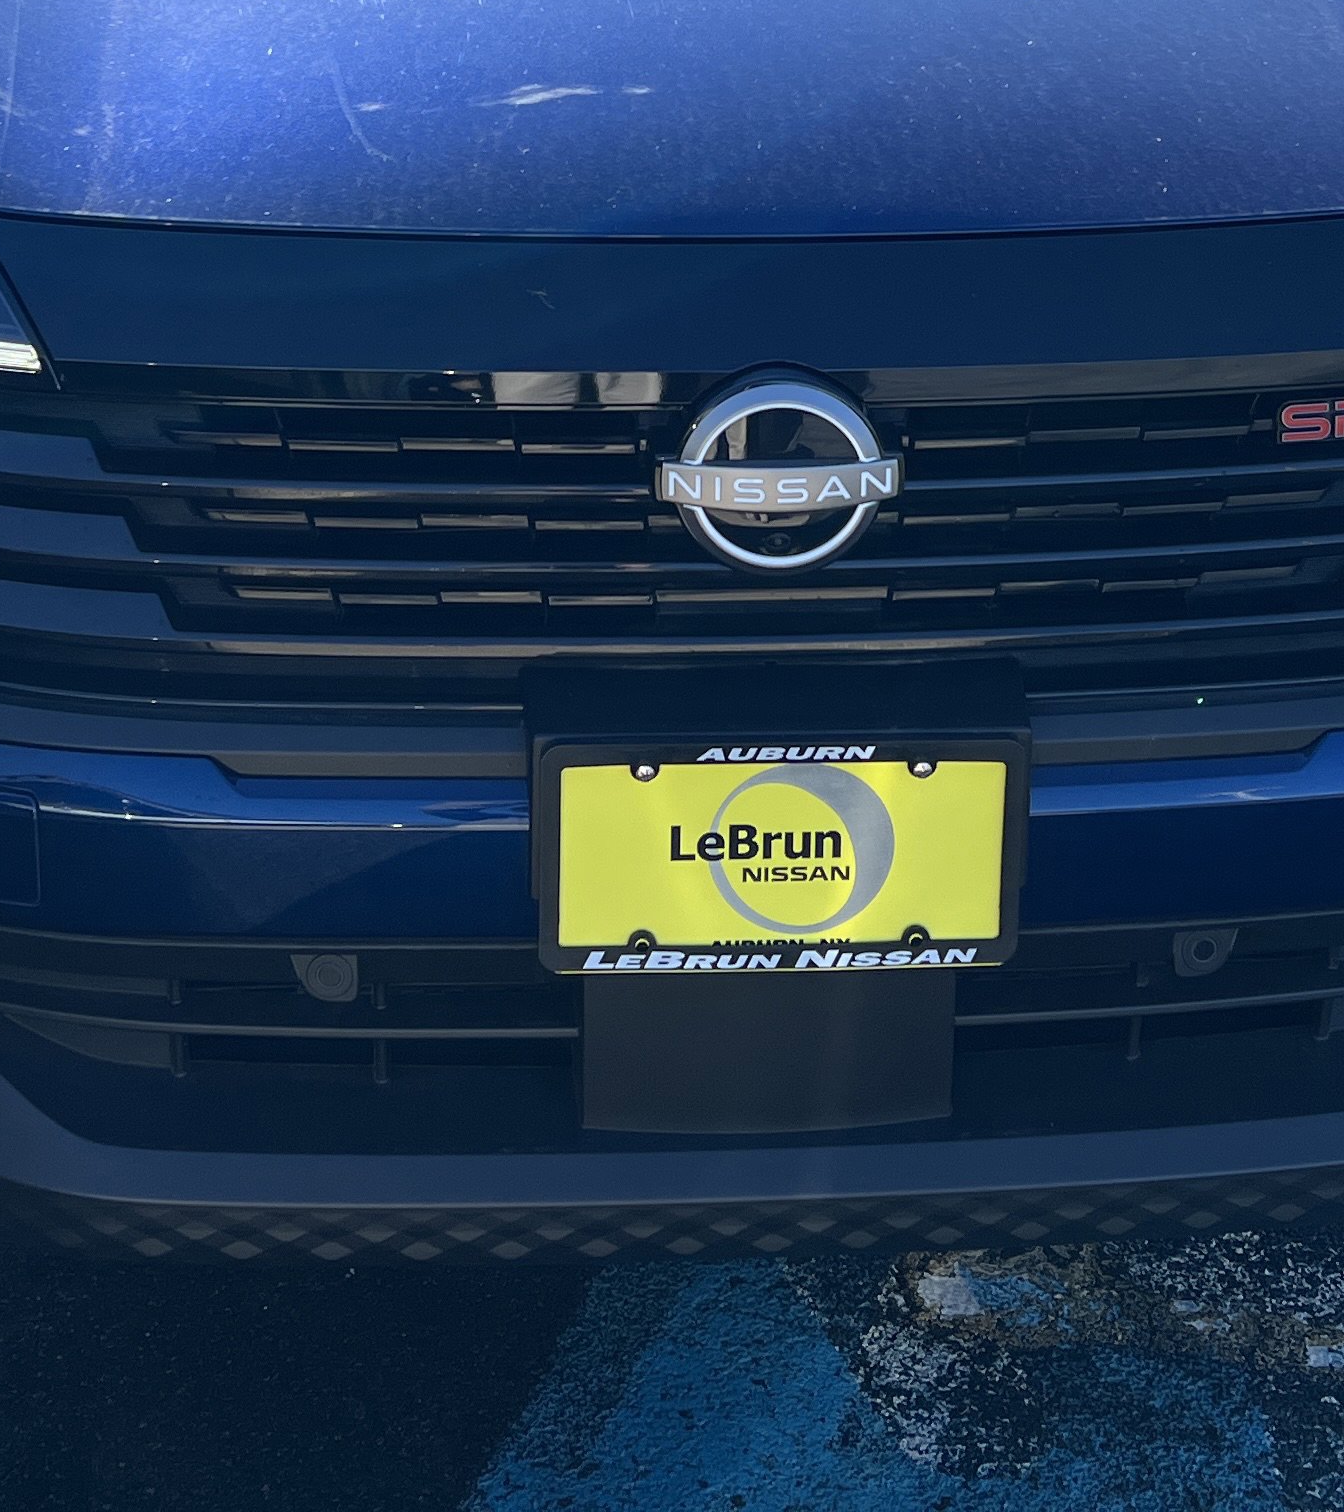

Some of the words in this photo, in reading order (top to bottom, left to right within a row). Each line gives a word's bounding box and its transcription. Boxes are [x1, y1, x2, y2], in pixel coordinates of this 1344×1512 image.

[666, 467, 894, 505] NISSAN
[696, 744, 878, 762] AUBURN
[669, 824, 843, 862] LeBrun
[742, 866, 851, 883] NISSAN
